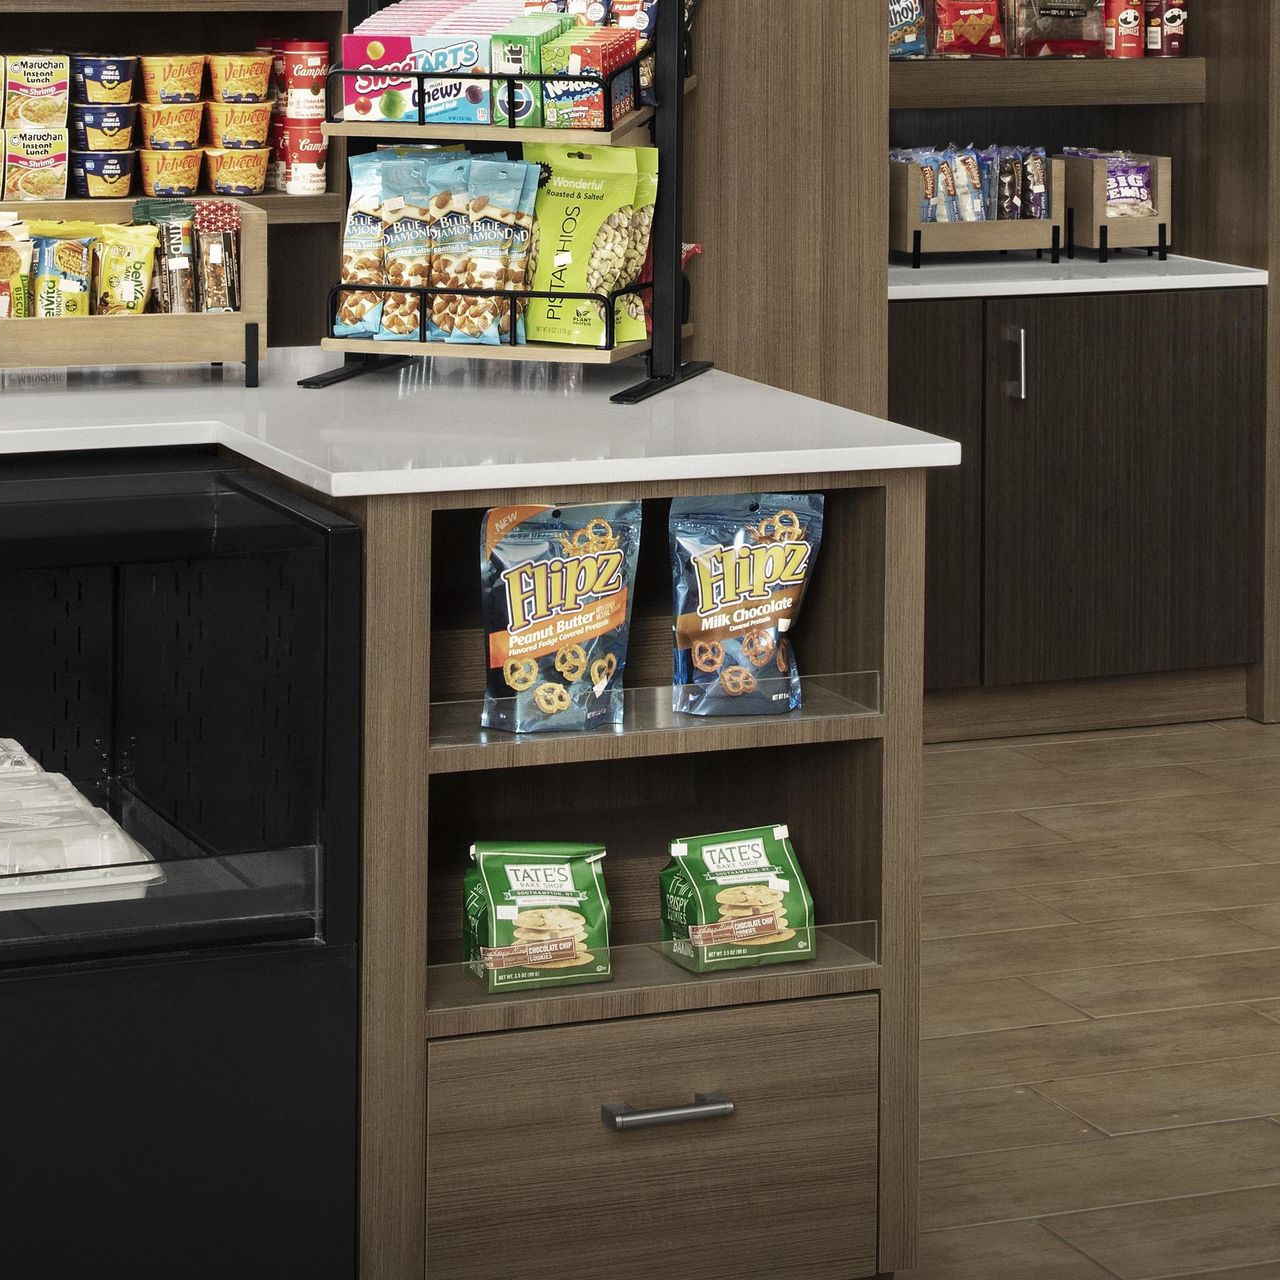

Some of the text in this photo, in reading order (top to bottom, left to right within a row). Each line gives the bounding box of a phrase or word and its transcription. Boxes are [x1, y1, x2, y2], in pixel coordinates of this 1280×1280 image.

[20, 60, 64, 70] Maruchan
[23, 70, 54, 78] Instant
[26, 76, 50, 84] Lunch
[29, 86, 56, 96] Shrimp
[152, 108, 199, 129] Velveeta
[19, 133, 63, 143] Maruchan
[25, 148, 49, 156] Lunch
[28, 158, 55, 168] Shrimp
[215, 154, 263, 173] Velveeta
[553, 176, 604, 190] Wonderful
[546, 189, 574, 199] Roasted
[583, 192, 604, 201] Salted
[349, 215, 373, 226] BLUE
[393, 221, 420, 233] BLUE
[441, 216, 468, 229] BLUE
[473, 221, 500, 232] BLUE
[172, 221, 183, 255] KIND
[546, 205, 581, 320] PISTAHIOS
[495, 511, 518, 532] NEW
[692, 542, 810, 616] Flipz
[502, 551, 623, 633] Flipz
[701, 597, 792, 632] Milk Chocolate
[509, 611, 595, 648] Peanut Butter
[729, 622, 750, 632] Covered
[509, 619, 609, 656] Flavored Fudge Covered Pretzels
[706, 843, 763, 865] TATE'S
[509, 867, 569, 883] TATE'S
[666, 894, 689, 913] CRISPY
[734, 917, 774, 930] CHOCOLATE CHIP
[528, 943, 558, 954] CHOCOLATE
[559, 941, 572, 950] CHIP
[672, 938, 694, 958] BAKING
